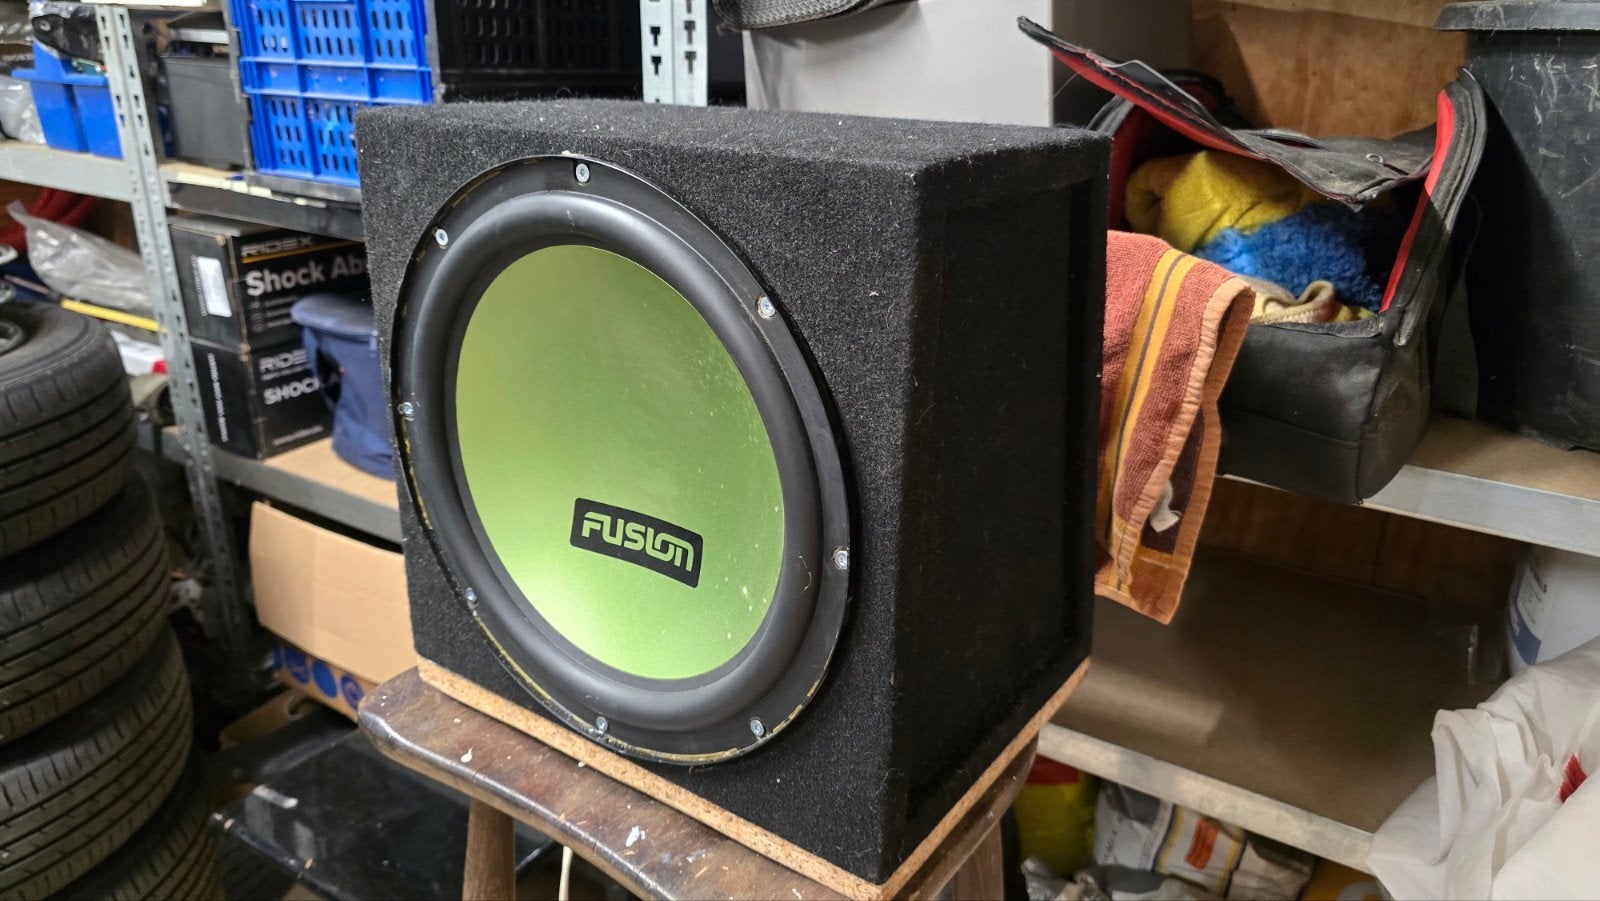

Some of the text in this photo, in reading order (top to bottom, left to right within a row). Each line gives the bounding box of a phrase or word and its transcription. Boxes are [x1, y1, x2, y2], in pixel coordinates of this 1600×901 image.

[246, 261, 325, 296] Shock
[259, 348, 307, 373] RIDE
[581, 511, 695, 572] FUSION
